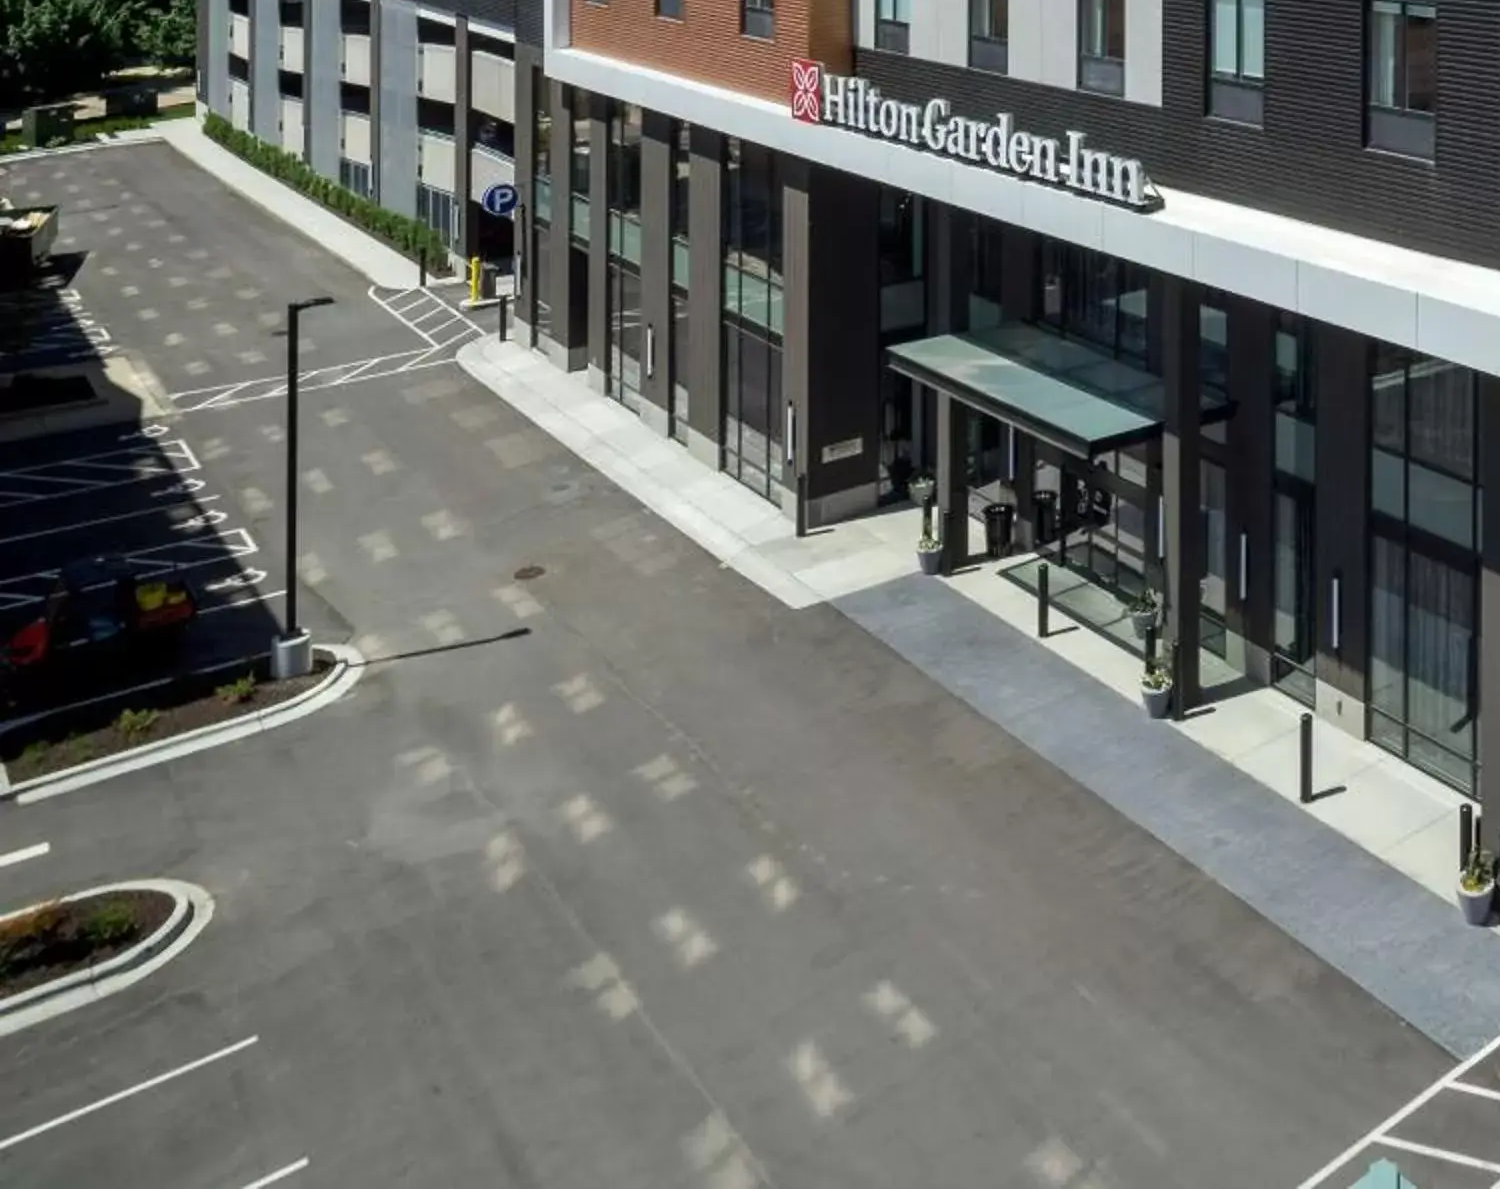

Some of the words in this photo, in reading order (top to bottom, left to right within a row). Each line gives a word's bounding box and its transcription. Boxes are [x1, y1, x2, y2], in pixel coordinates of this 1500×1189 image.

[823, 74, 921, 143] Hilton
[922, 98, 1059, 181] Garden
[1067, 130, 1147, 204] Inn
[494, 188, 513, 212] P
